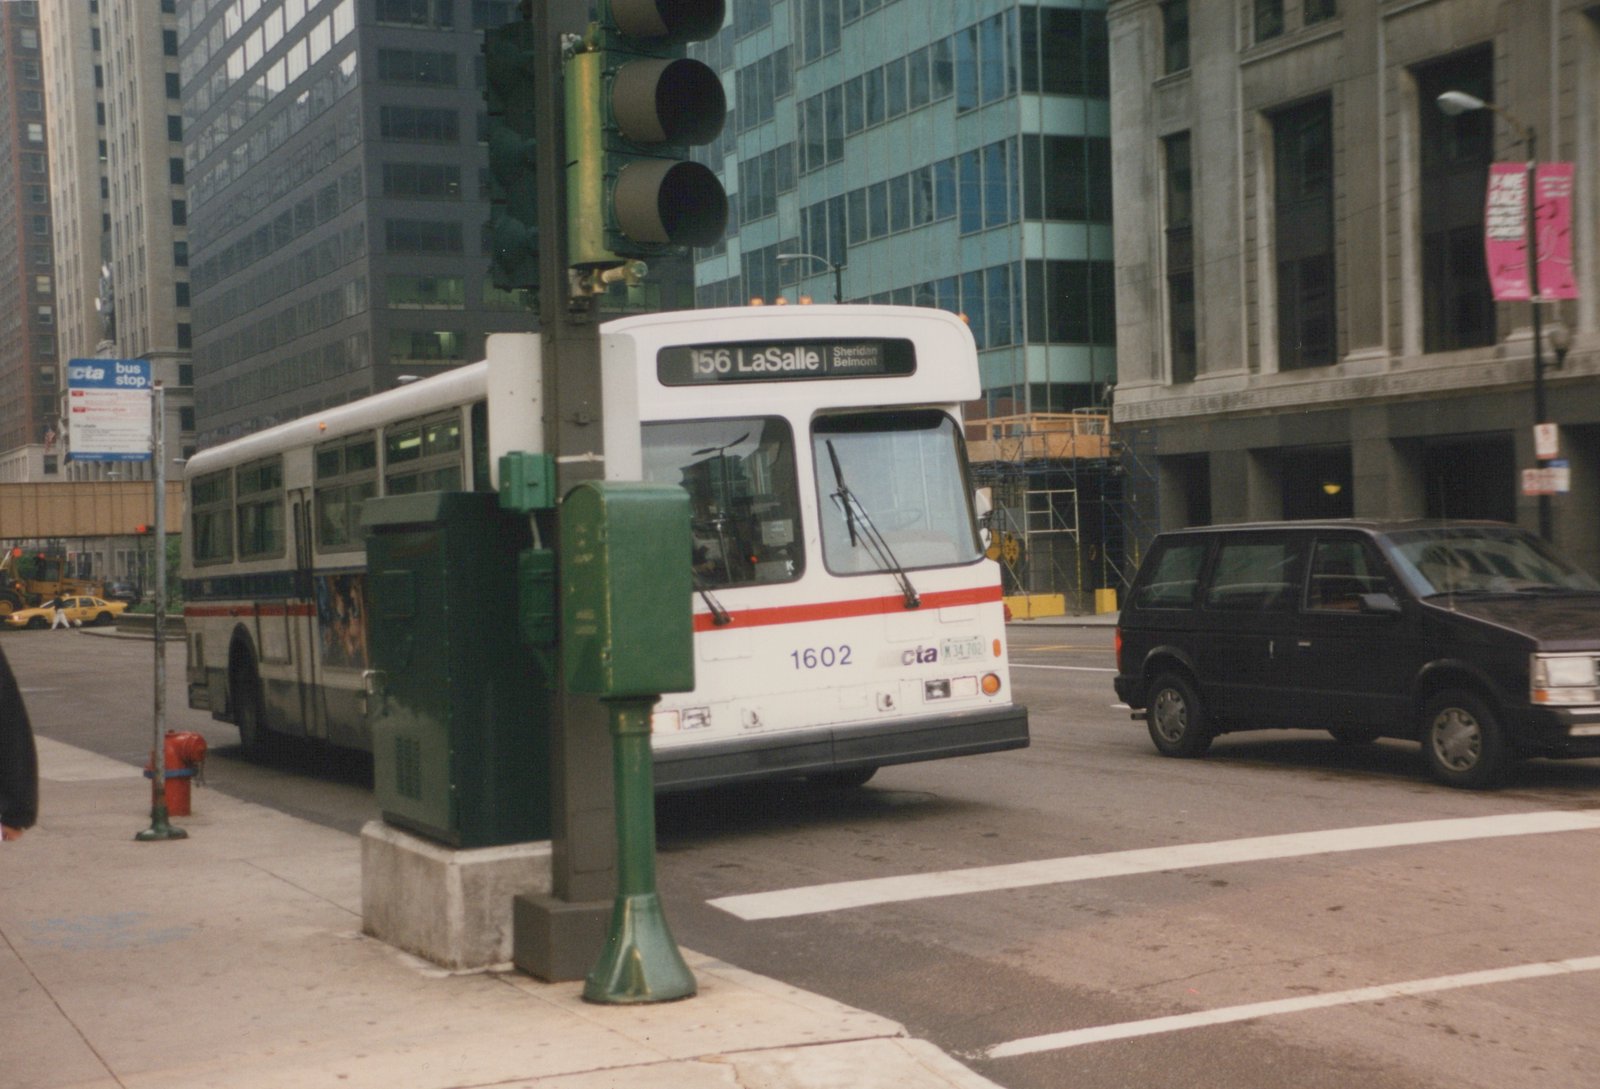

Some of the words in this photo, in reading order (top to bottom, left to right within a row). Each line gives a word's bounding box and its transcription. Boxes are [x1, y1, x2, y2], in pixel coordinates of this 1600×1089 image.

[833, 346, 878, 357] Sheridan
[691, 348, 731, 374] 156
[738, 345, 820, 372] LaSalle
[833, 356, 878, 367] Belmont
[74, 366, 105, 380] cta
[115, 362, 141, 374] bus
[115, 374, 146, 387] stop
[791, 645, 852, 669] 1602
[901, 645, 938, 666] cta
